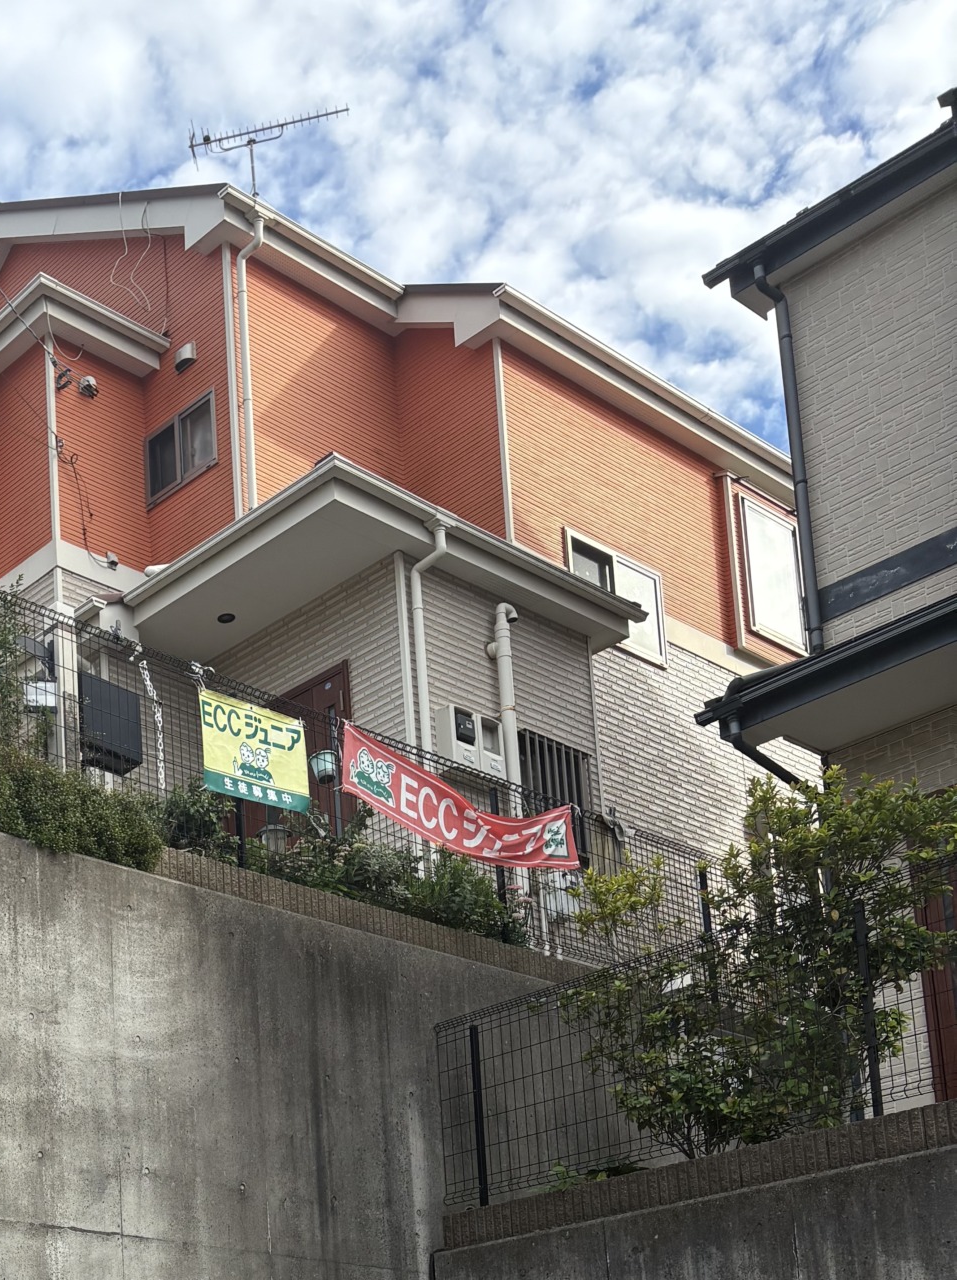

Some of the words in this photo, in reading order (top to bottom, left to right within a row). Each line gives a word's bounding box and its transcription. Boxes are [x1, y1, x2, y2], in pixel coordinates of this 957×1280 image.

[201, 699, 301, 751] ECCジュニア
[224, 776, 292, 804] 生徒募集中
